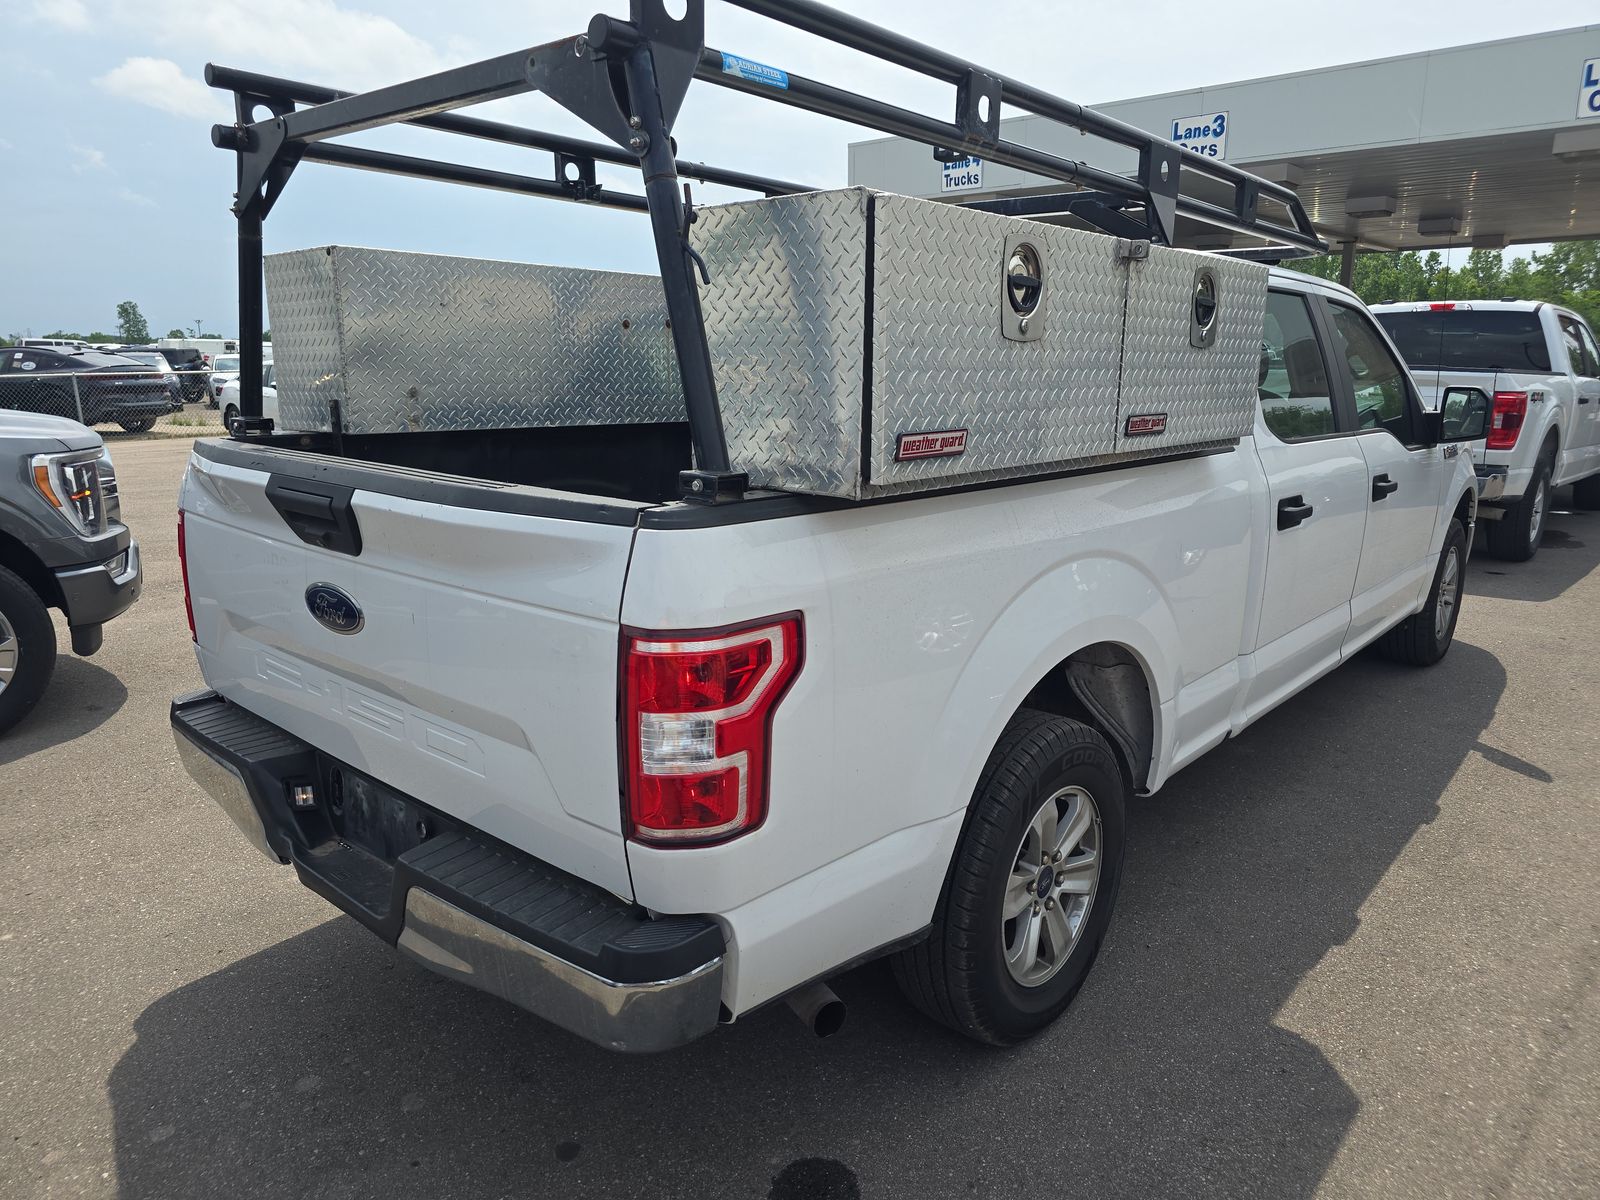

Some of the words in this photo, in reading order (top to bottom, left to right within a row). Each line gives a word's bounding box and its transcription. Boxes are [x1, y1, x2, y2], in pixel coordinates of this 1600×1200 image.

[738, 60, 762, 74] ADRIAN
[762, 67, 782, 79] STEEL
[944, 171, 979, 188] Trucks
[903, 436, 939, 452] weather
[940, 433, 964, 450] guard
[314, 592, 346, 625] Ford
[255, 650, 487, 779] F-150
